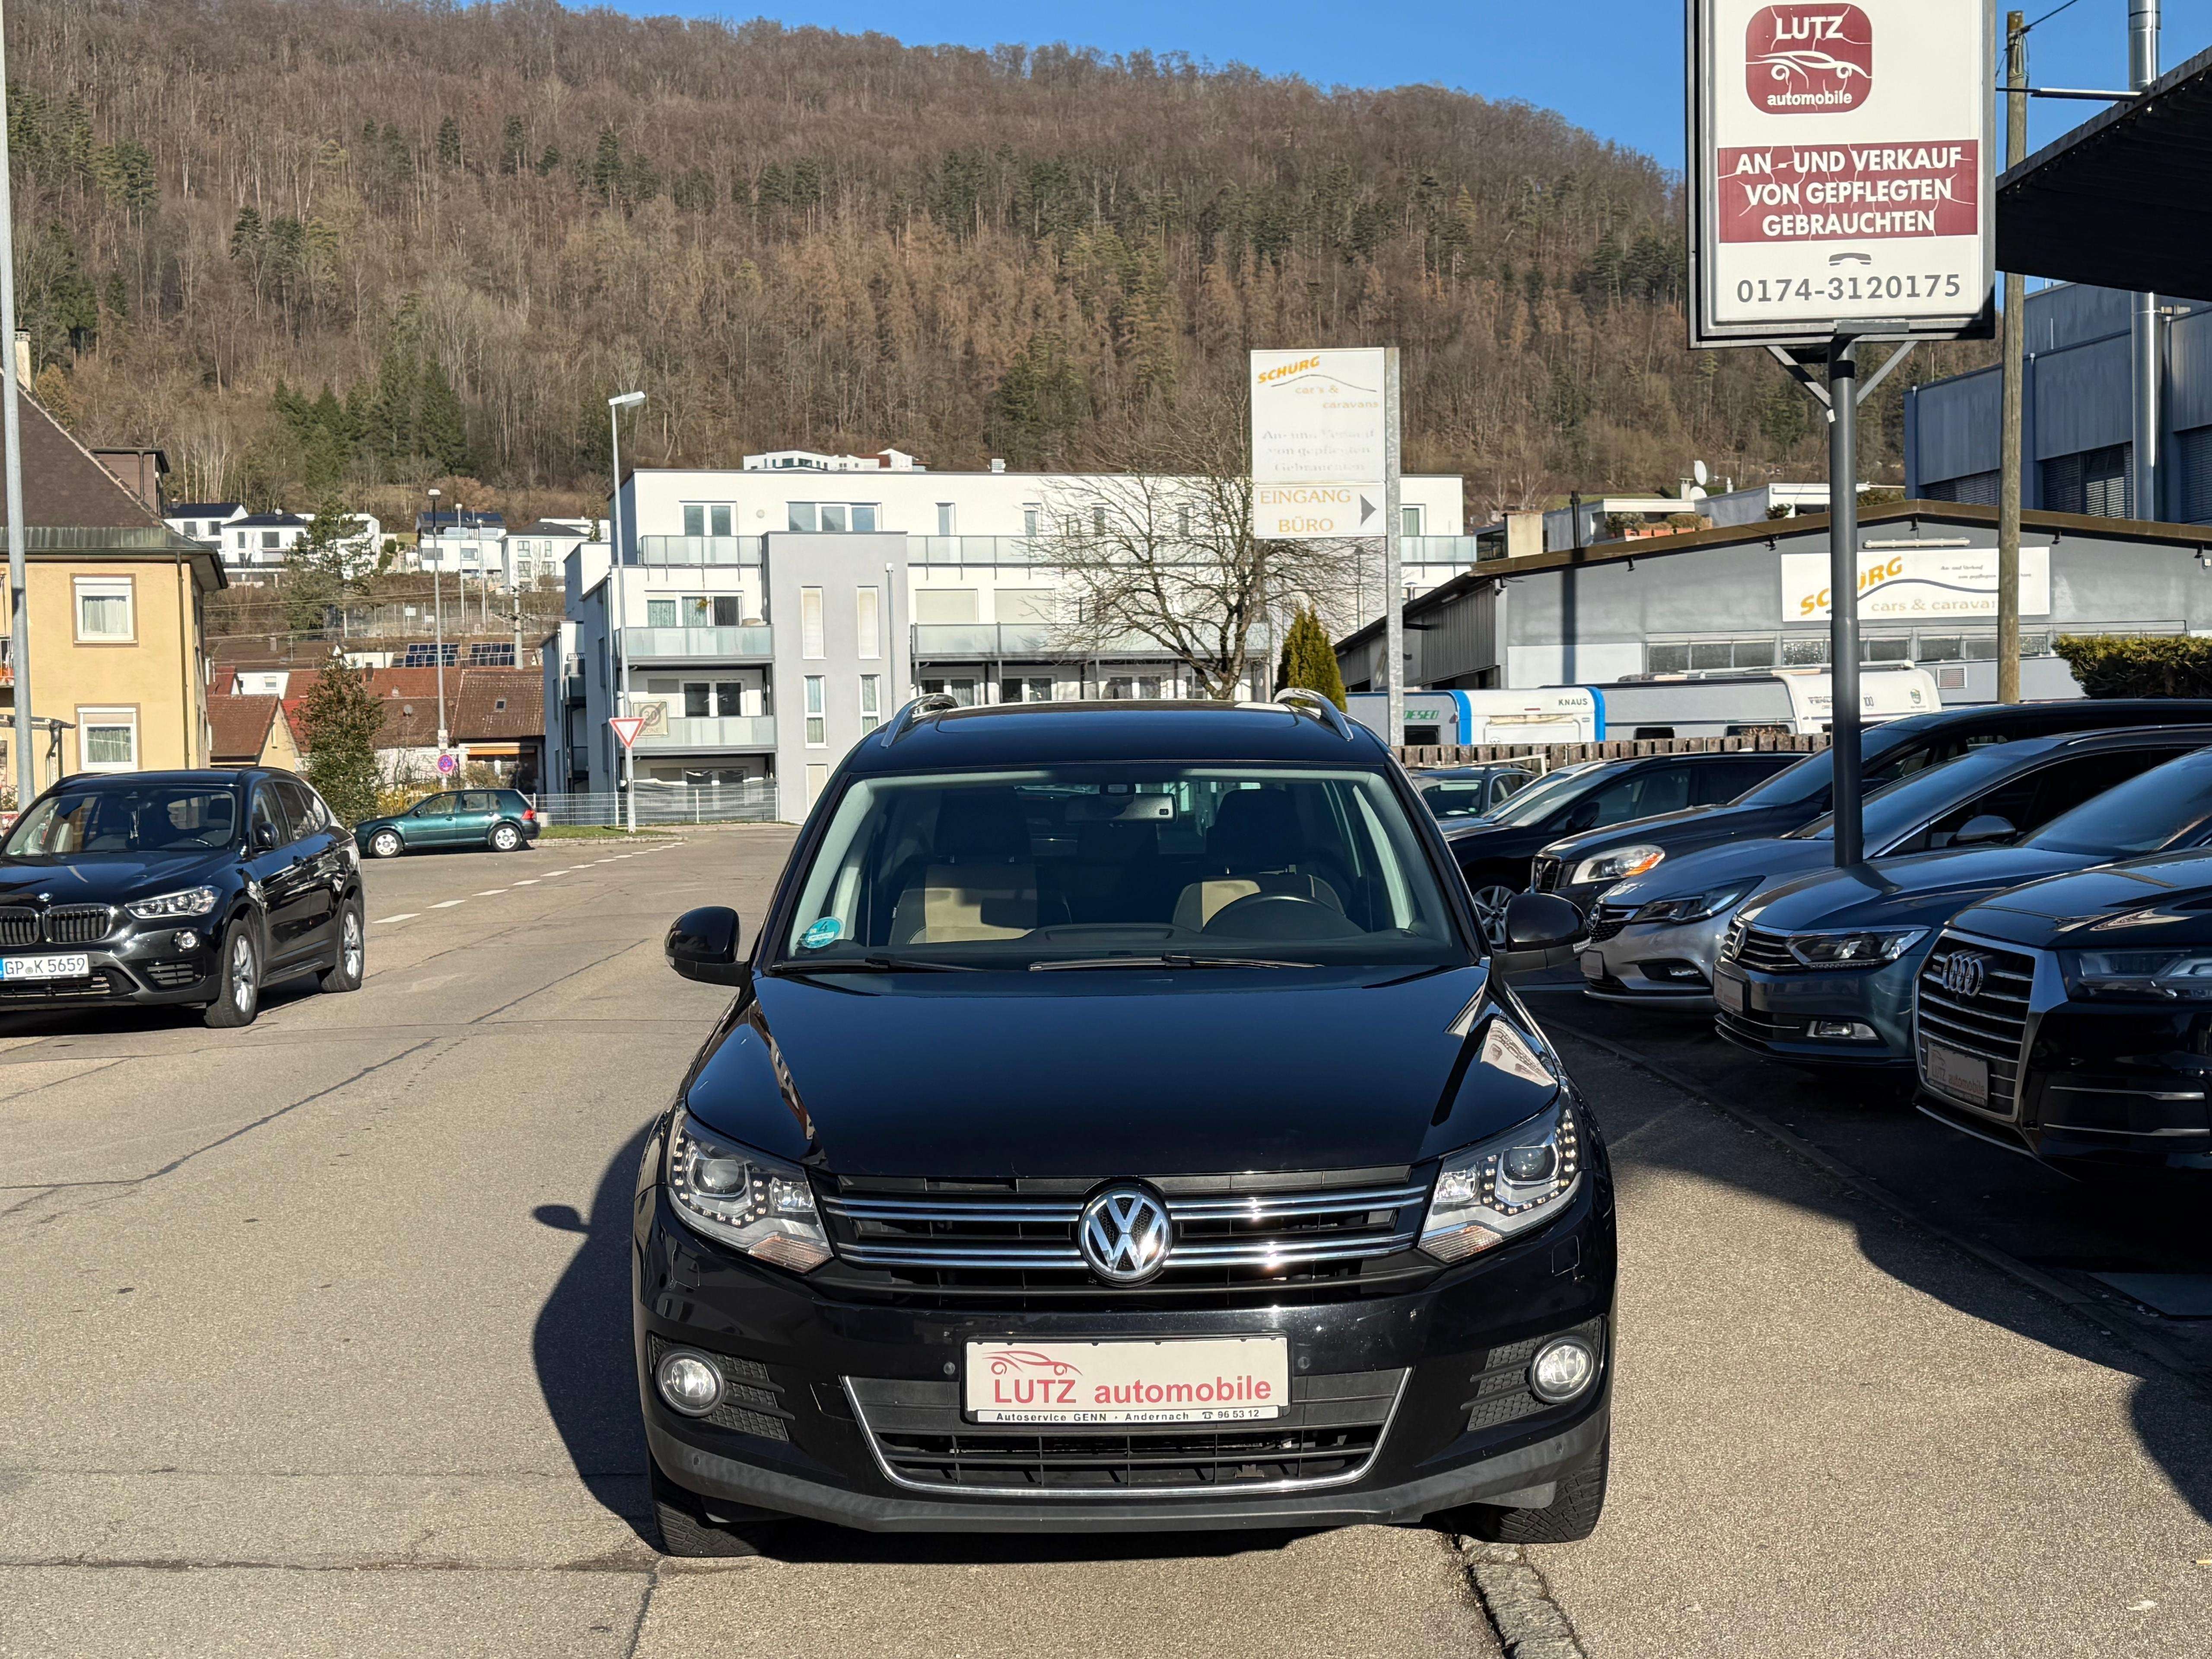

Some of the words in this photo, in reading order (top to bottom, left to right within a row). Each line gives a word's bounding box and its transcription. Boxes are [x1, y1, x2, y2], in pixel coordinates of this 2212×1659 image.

[1776, 16, 1843, 39] LUTZ
[1767, 91, 1853, 106] automobile
[1853, 147, 1962, 171] VERKAUF
[1745, 183, 1799, 206] VON
[1806, 178, 1952, 204] GEPFLEGTEN
[1762, 210, 1935, 236] GEBRAUCHTEN
[1737, 274, 1961, 302] 0174-3120175
[1258, 356, 1320, 384] SCHURG
[1328, 385, 1339, 394] &
[1322, 401, 1379, 409] caravans
[1259, 489, 1351, 505] EINGANG
[1278, 515, 1334, 533] BÜRO
[1800, 556, 1903, 616] SCRG
[1871, 602, 1906, 612] cars
[1911, 598, 1926, 610] &
[1558, 698, 1589, 706] KNAUS
[5, 961, 24, 975] GP
[34, 960, 44, 973] K
[48, 957, 85, 973] 5659
[995, 1378, 1077, 1404] LUTZ
[1094, 1375, 1271, 1404] automobile
[996, 1412, 1067, 1421] Autoservice
[1073, 1413, 1107, 1421] GENN
[1125, 1411, 1189, 1421] Andernach
[1248, 1409, 1259, 1417] 12
